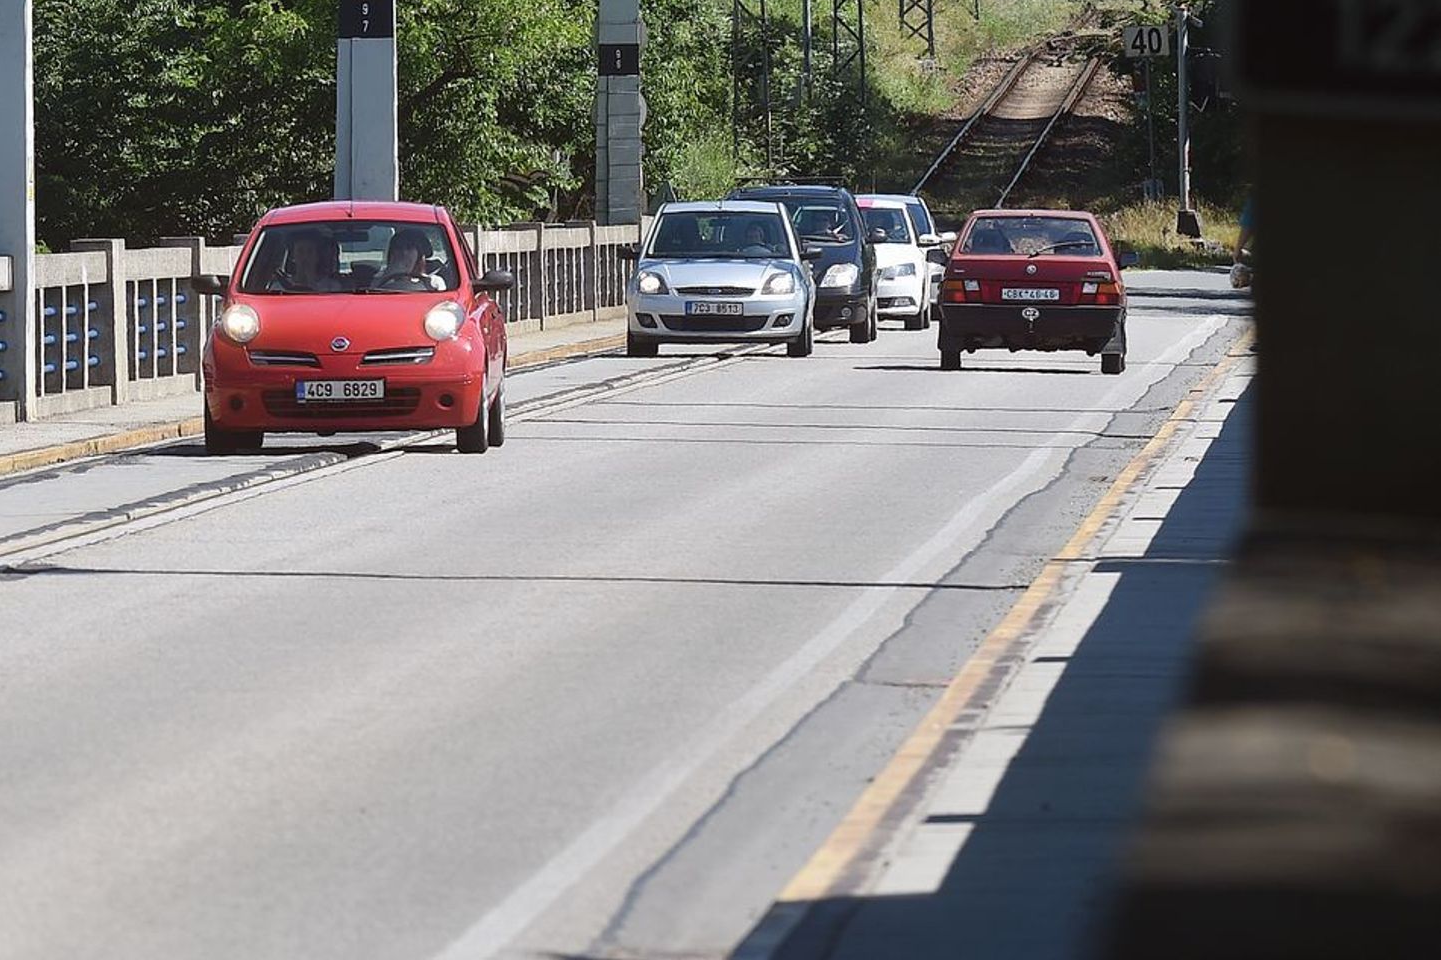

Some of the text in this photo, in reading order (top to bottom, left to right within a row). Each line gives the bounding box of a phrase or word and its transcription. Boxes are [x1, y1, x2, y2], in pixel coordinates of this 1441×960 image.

[1131, 27, 1163, 54] 40
[307, 382, 378, 397] 4C9 6829
